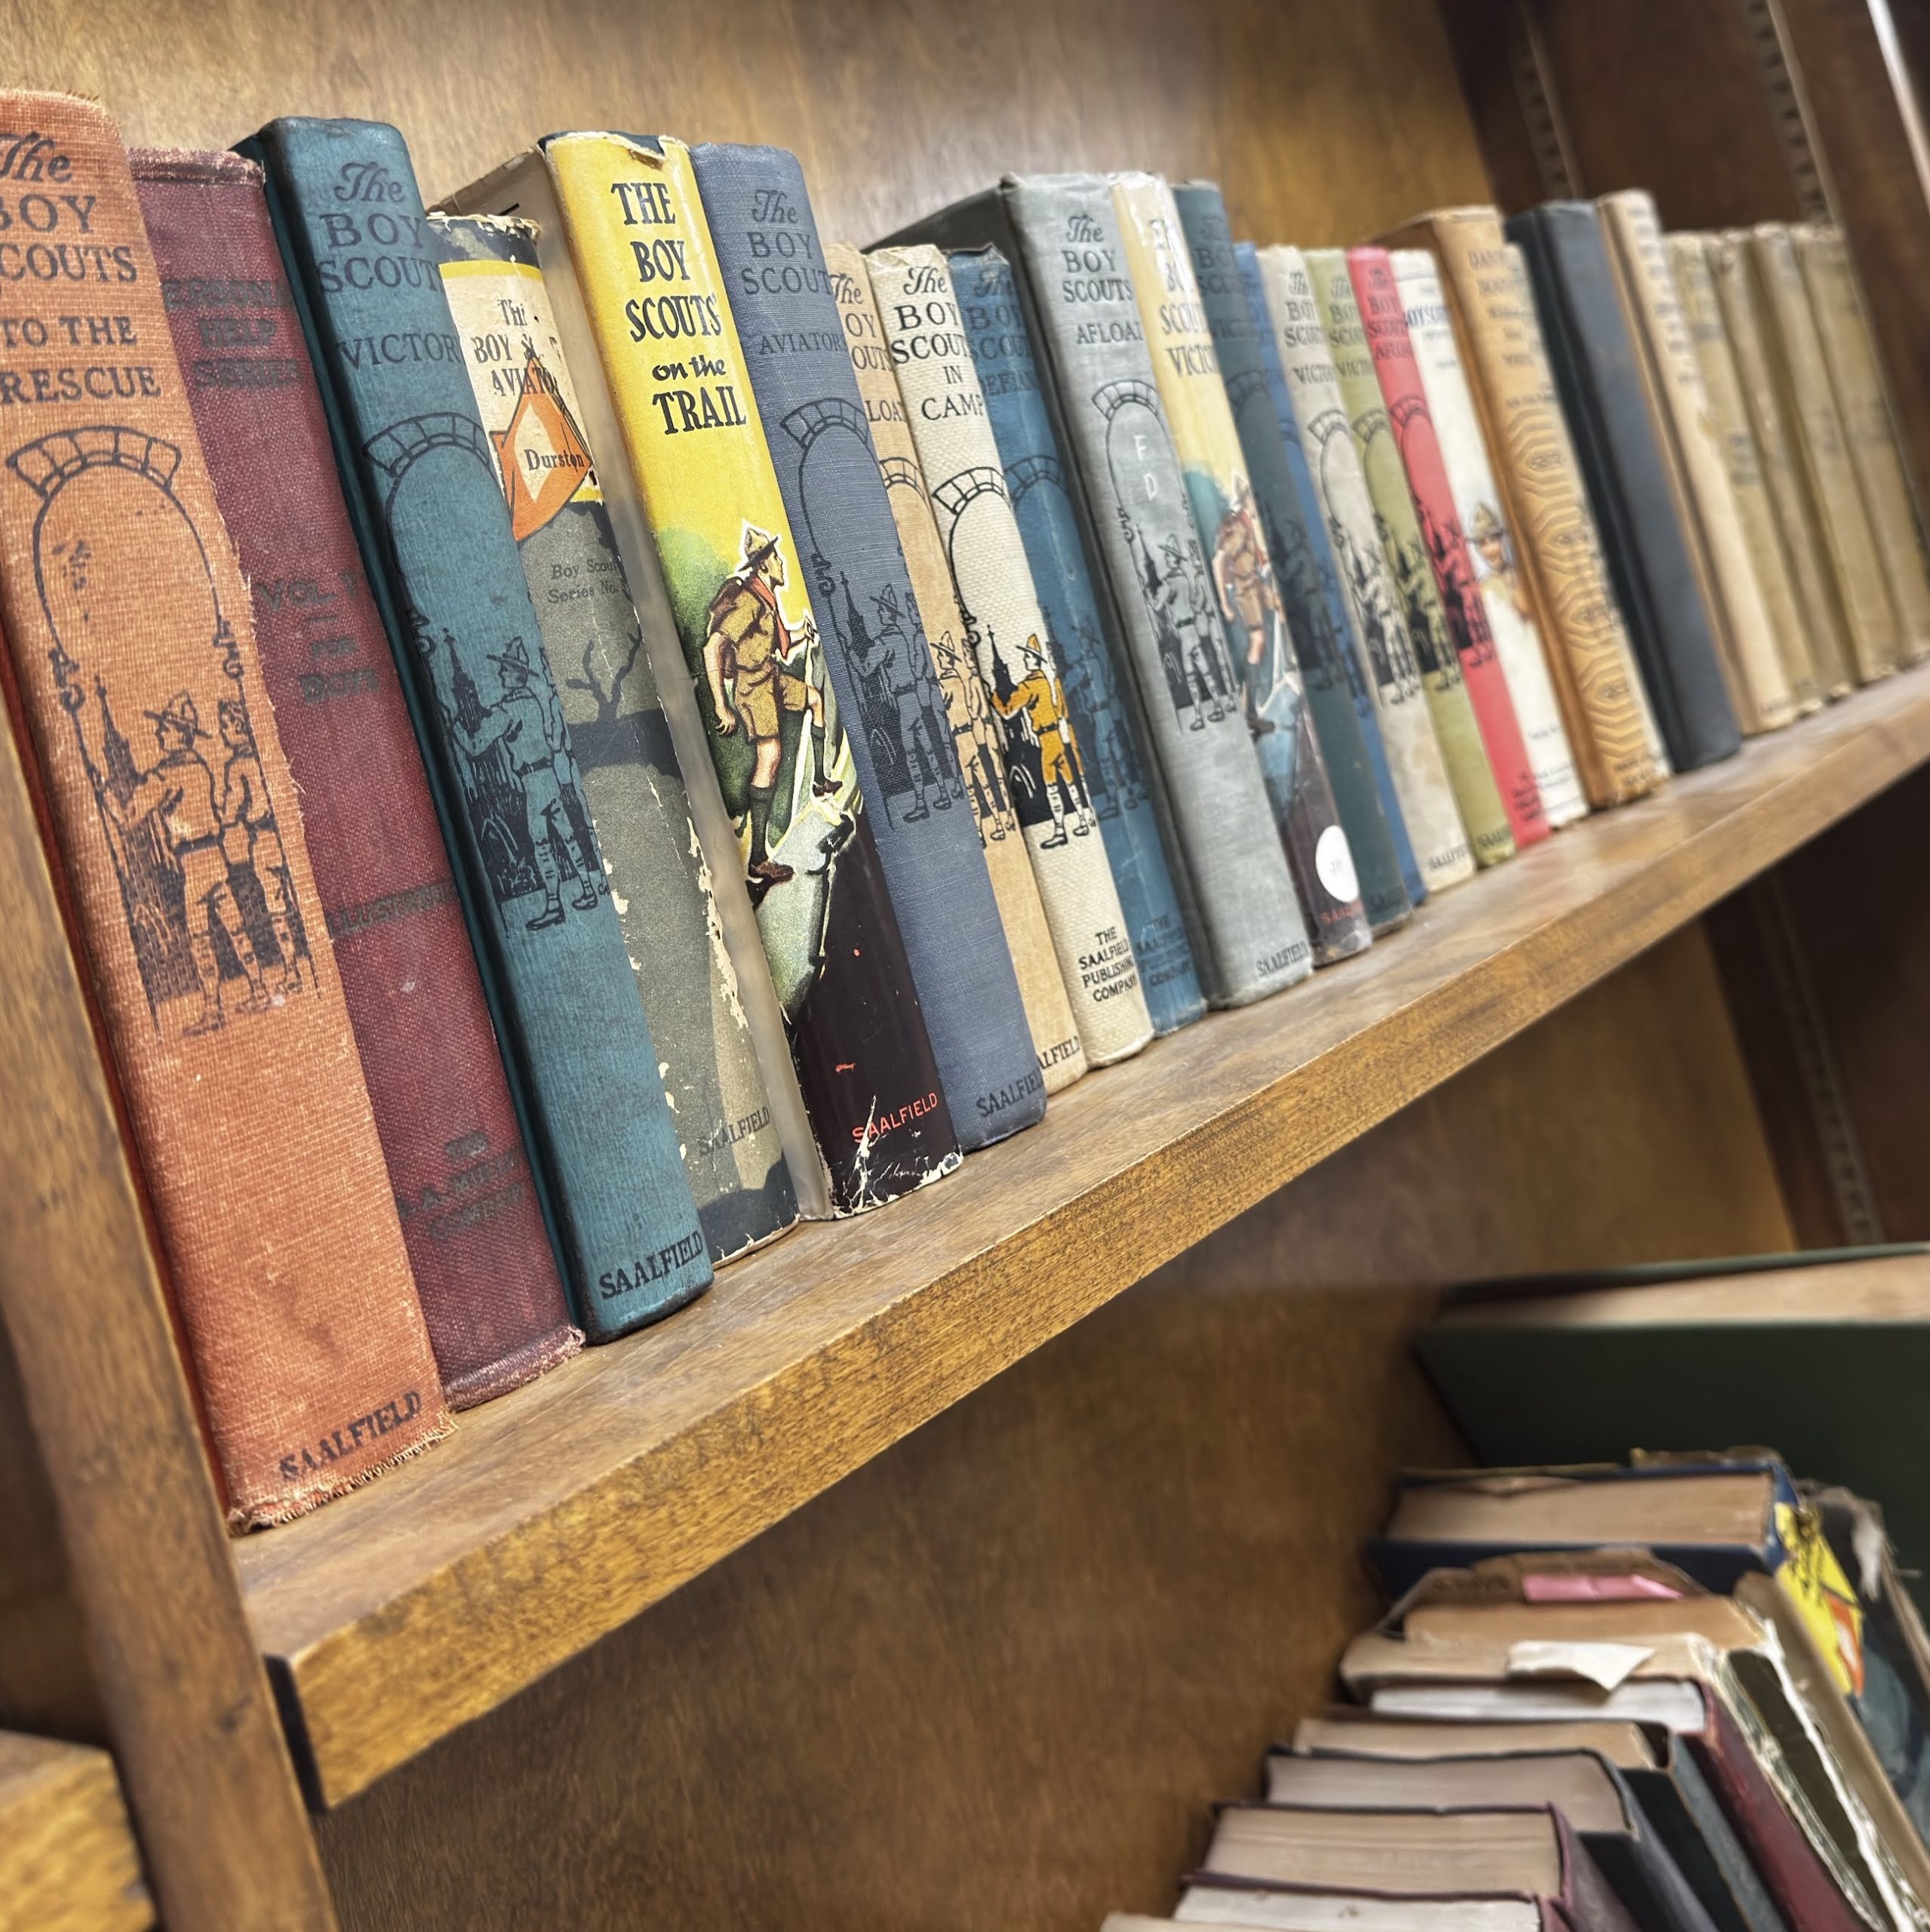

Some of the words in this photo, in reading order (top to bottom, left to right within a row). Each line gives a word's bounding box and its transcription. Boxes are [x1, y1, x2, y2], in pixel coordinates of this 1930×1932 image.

[333, 161, 405, 203] The
[610, 182, 676, 226] THE
[751, 189, 799, 225] The
[319, 213, 424, 249] BOY
[1065, 214, 1104, 242] The
[746, 230, 814, 260] BOY
[0, 243, 137, 282] COUTS
[630, 239, 691, 283] BOY
[1062, 249, 1117, 273] BOY
[740, 266, 832, 297] SCOUT
[903, 266, 947, 295] The
[1, 318, 48, 348] TO
[59, 315, 137, 346] THE
[625, 292, 722, 343] SCOUTS
[845, 312, 877, 339] OY
[893, 302, 960, 331] BOY
[471, 334, 513, 364] BOY
[652, 361, 688, 381] on
[689, 355, 727, 380] the
[942, 365, 964, 385] IN
[0, 366, 161, 405] RESCUE
[652, 386, 747, 435] TRAIL
[524, 448, 585, 472] Durston
[1133, 435, 1148, 461] F
[1144, 473, 1157, 501] D
[551, 565, 579, 580] Boy
[548, 584, 595, 604] Series
[1095, 926, 1117, 946] THE
[1078, 938, 1129, 971] SAALFIELD
[976, 1066, 1043, 1118] SAALFIEL
[852, 1092, 939, 1143] SAALFIELD
[599, 1229, 704, 1300] SAALFIELD
[278, 1389, 422, 1482] SAALFIELD
